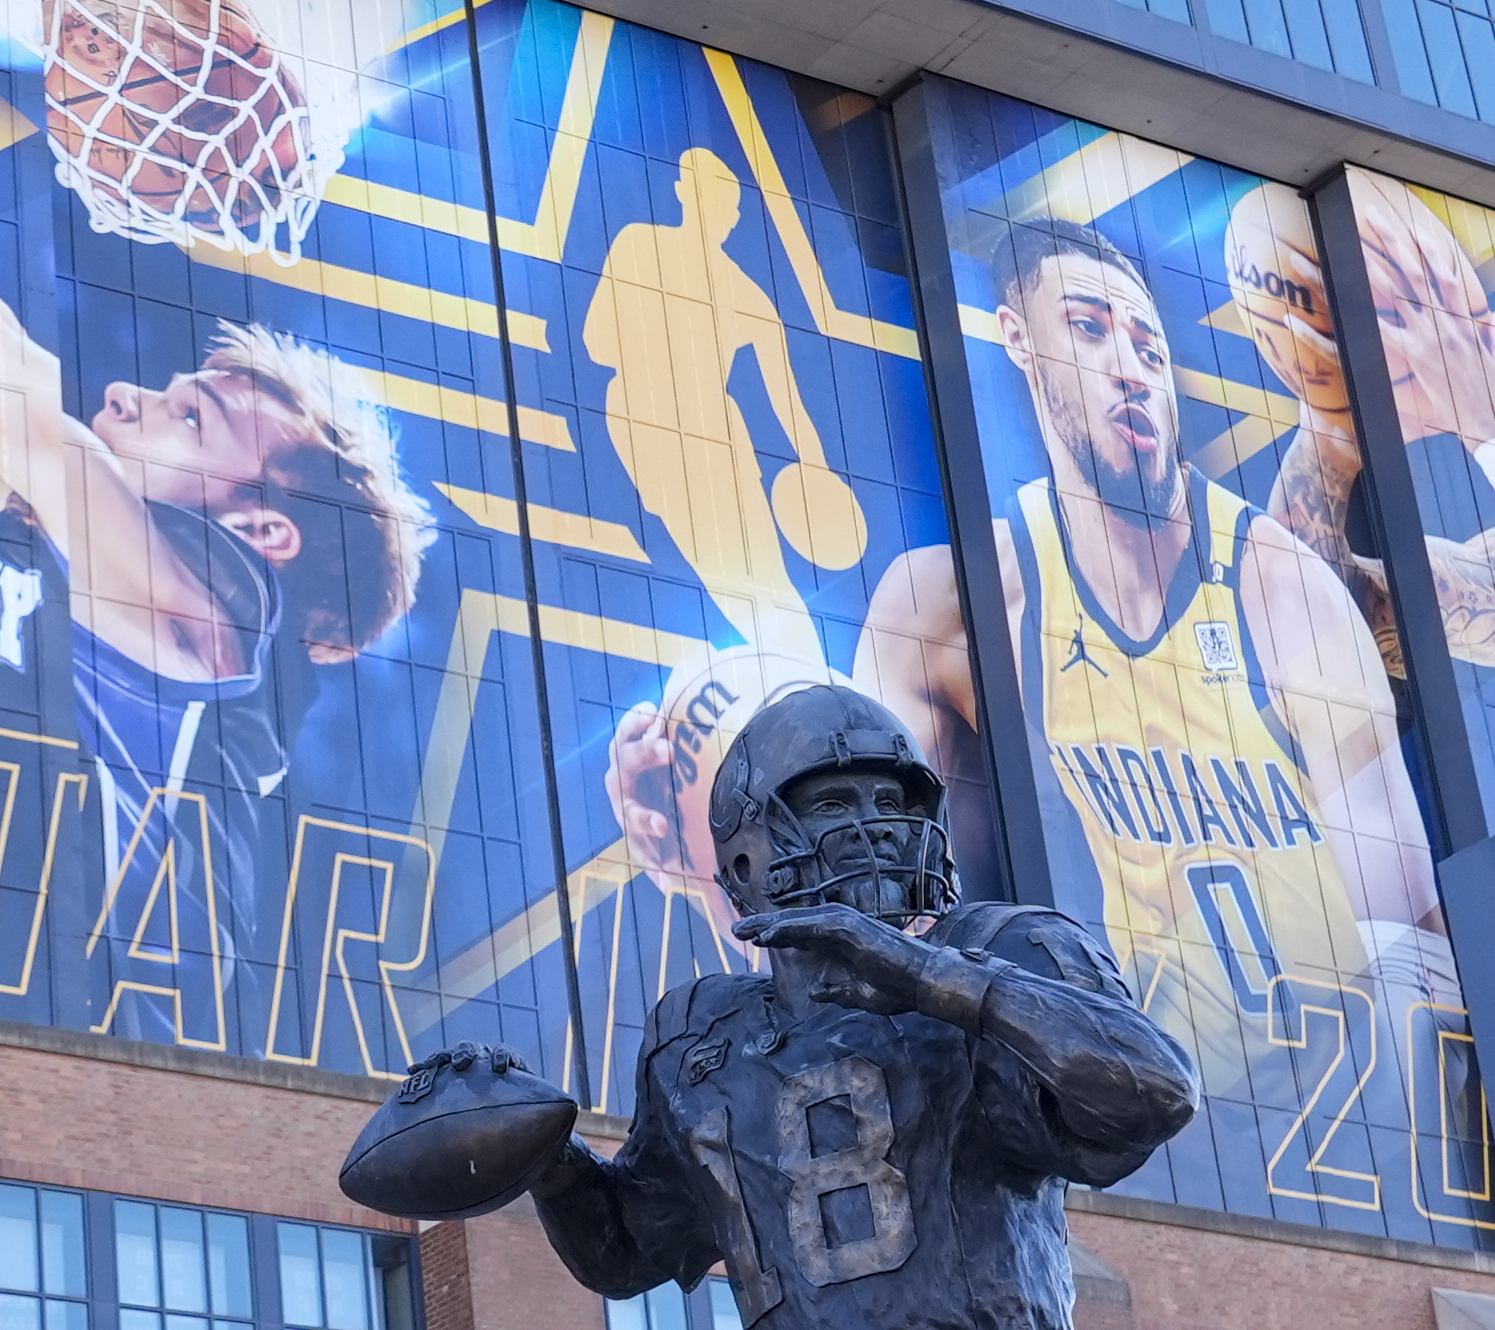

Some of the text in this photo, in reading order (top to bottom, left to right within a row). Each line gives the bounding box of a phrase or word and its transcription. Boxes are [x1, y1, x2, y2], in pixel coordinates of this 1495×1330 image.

[1050, 740, 1328, 852] INDIANA
[1183, 859, 1295, 1017] 0
[397, 1072, 431, 1099] NFL
